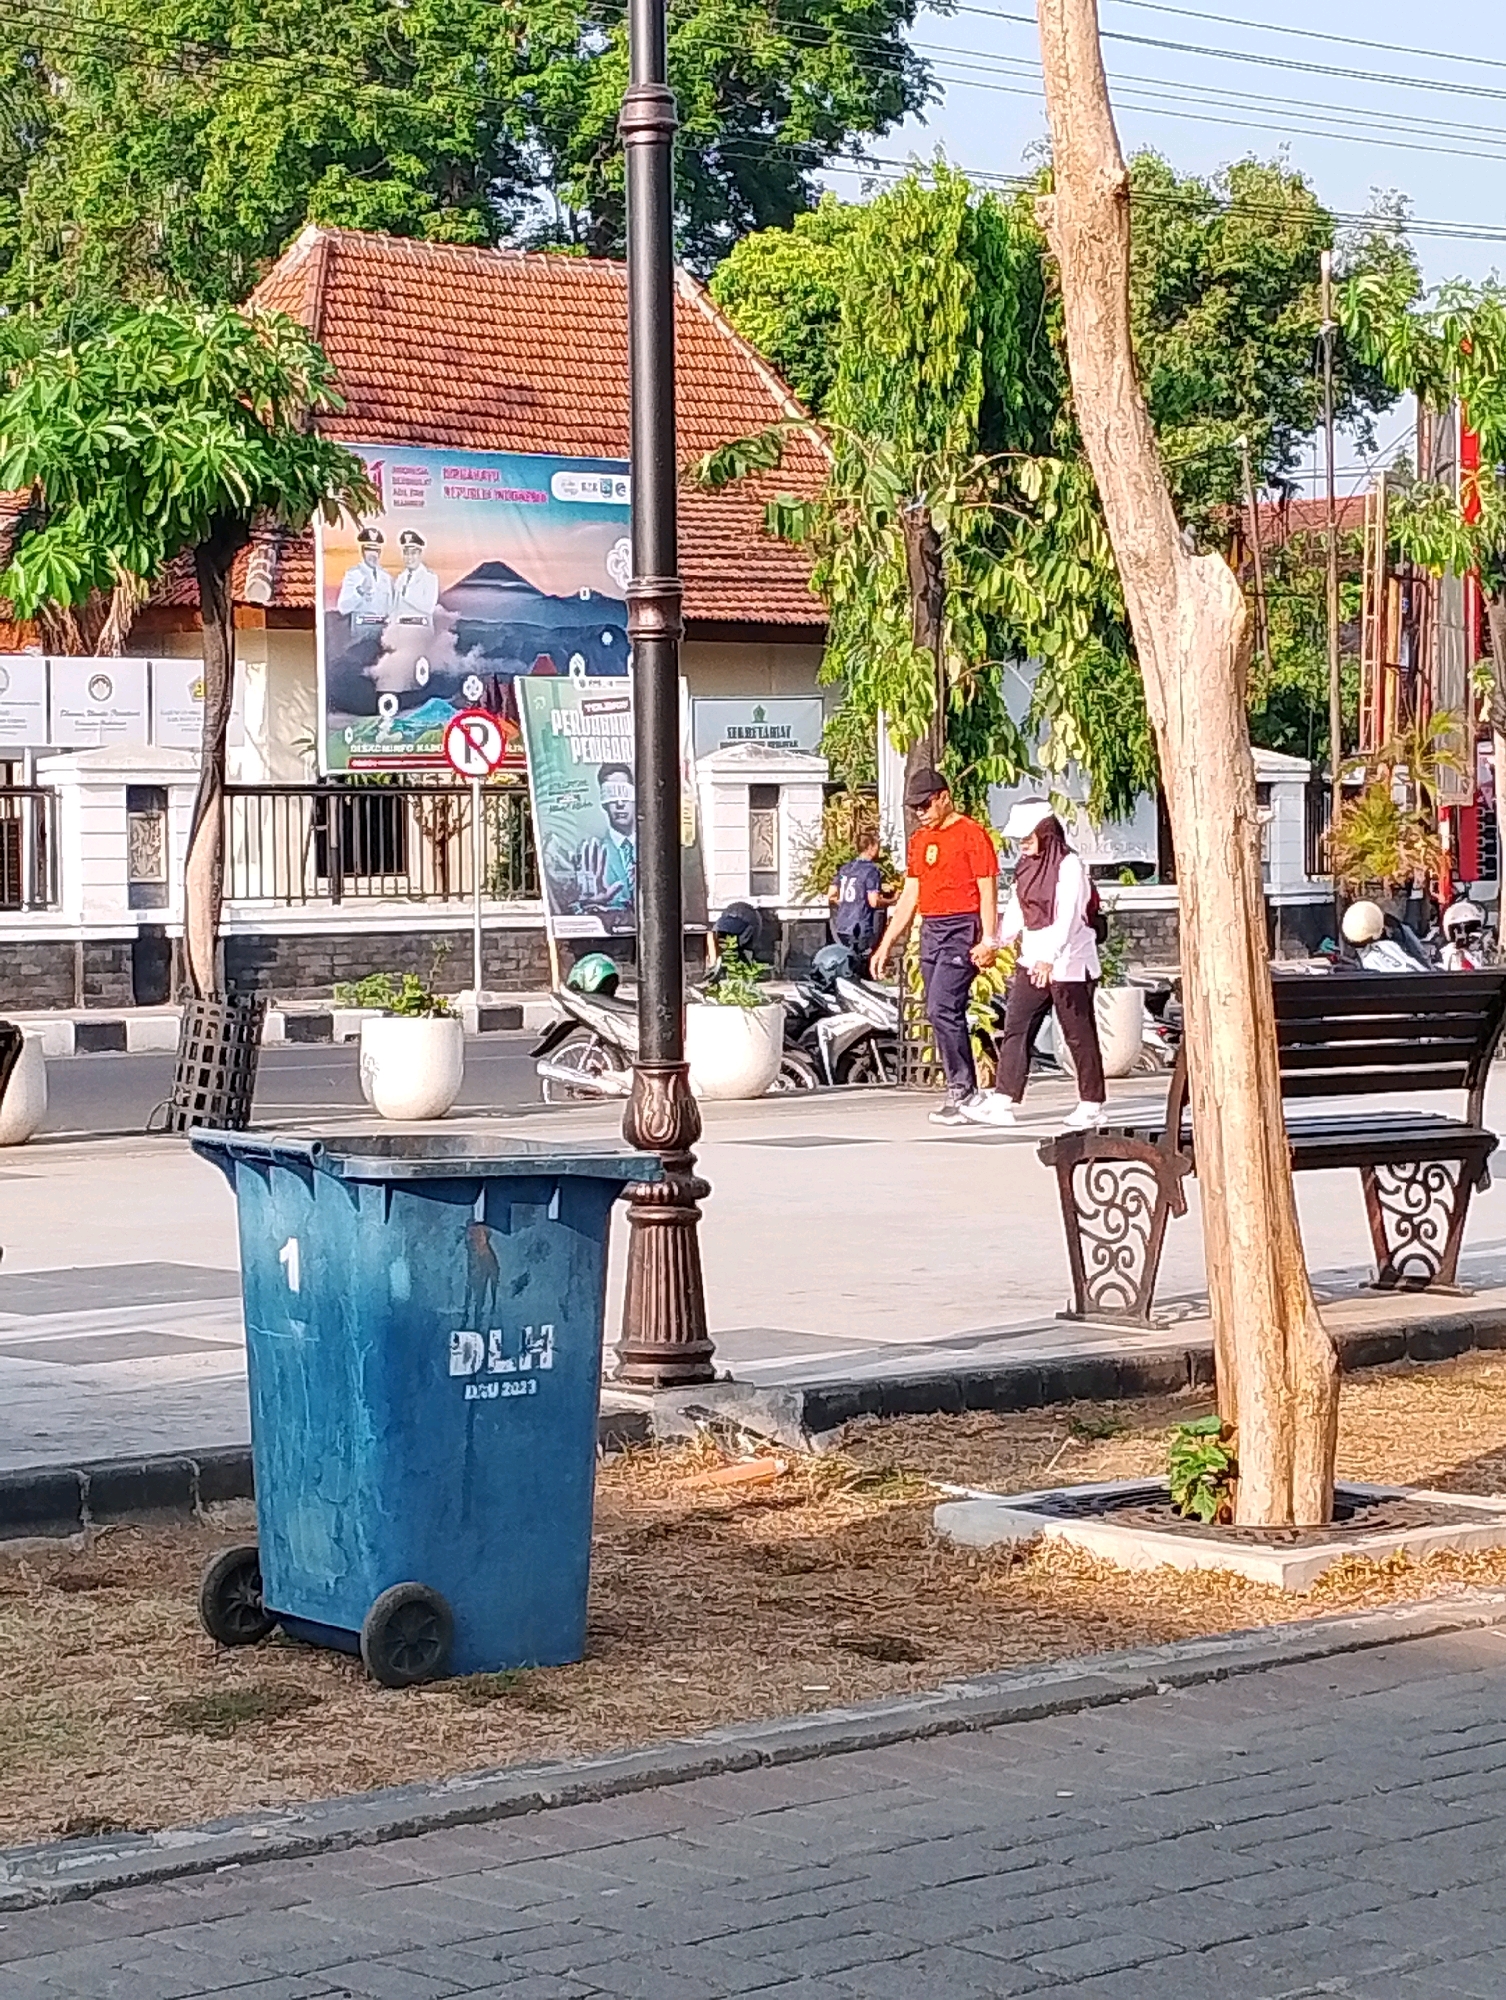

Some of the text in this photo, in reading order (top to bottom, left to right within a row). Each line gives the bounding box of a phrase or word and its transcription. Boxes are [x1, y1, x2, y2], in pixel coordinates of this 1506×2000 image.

[839, 875, 857, 903] 16
[278, 1236, 300, 1293] 1
[449, 1323, 555, 1377] DLH
